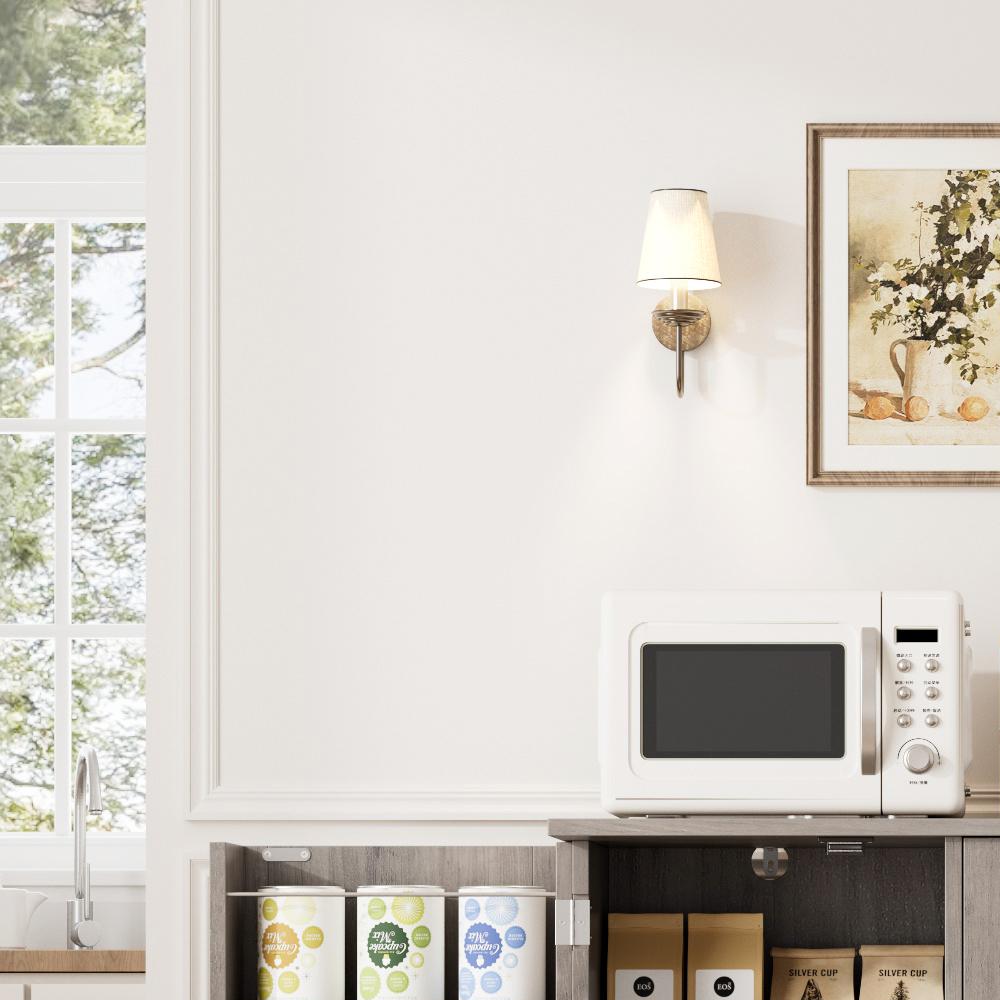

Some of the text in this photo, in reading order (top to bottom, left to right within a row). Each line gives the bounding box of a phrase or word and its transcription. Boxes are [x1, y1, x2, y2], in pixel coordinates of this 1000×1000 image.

[373, 931, 396, 942] Mix
[368, 942, 407, 954] Cupcake
[465, 943, 500, 955] Cupcake
[789, 968, 838, 977] SILVER CUP
[878, 969, 928, 977] SILVER CUP
[717, 983, 732, 991] EOS
